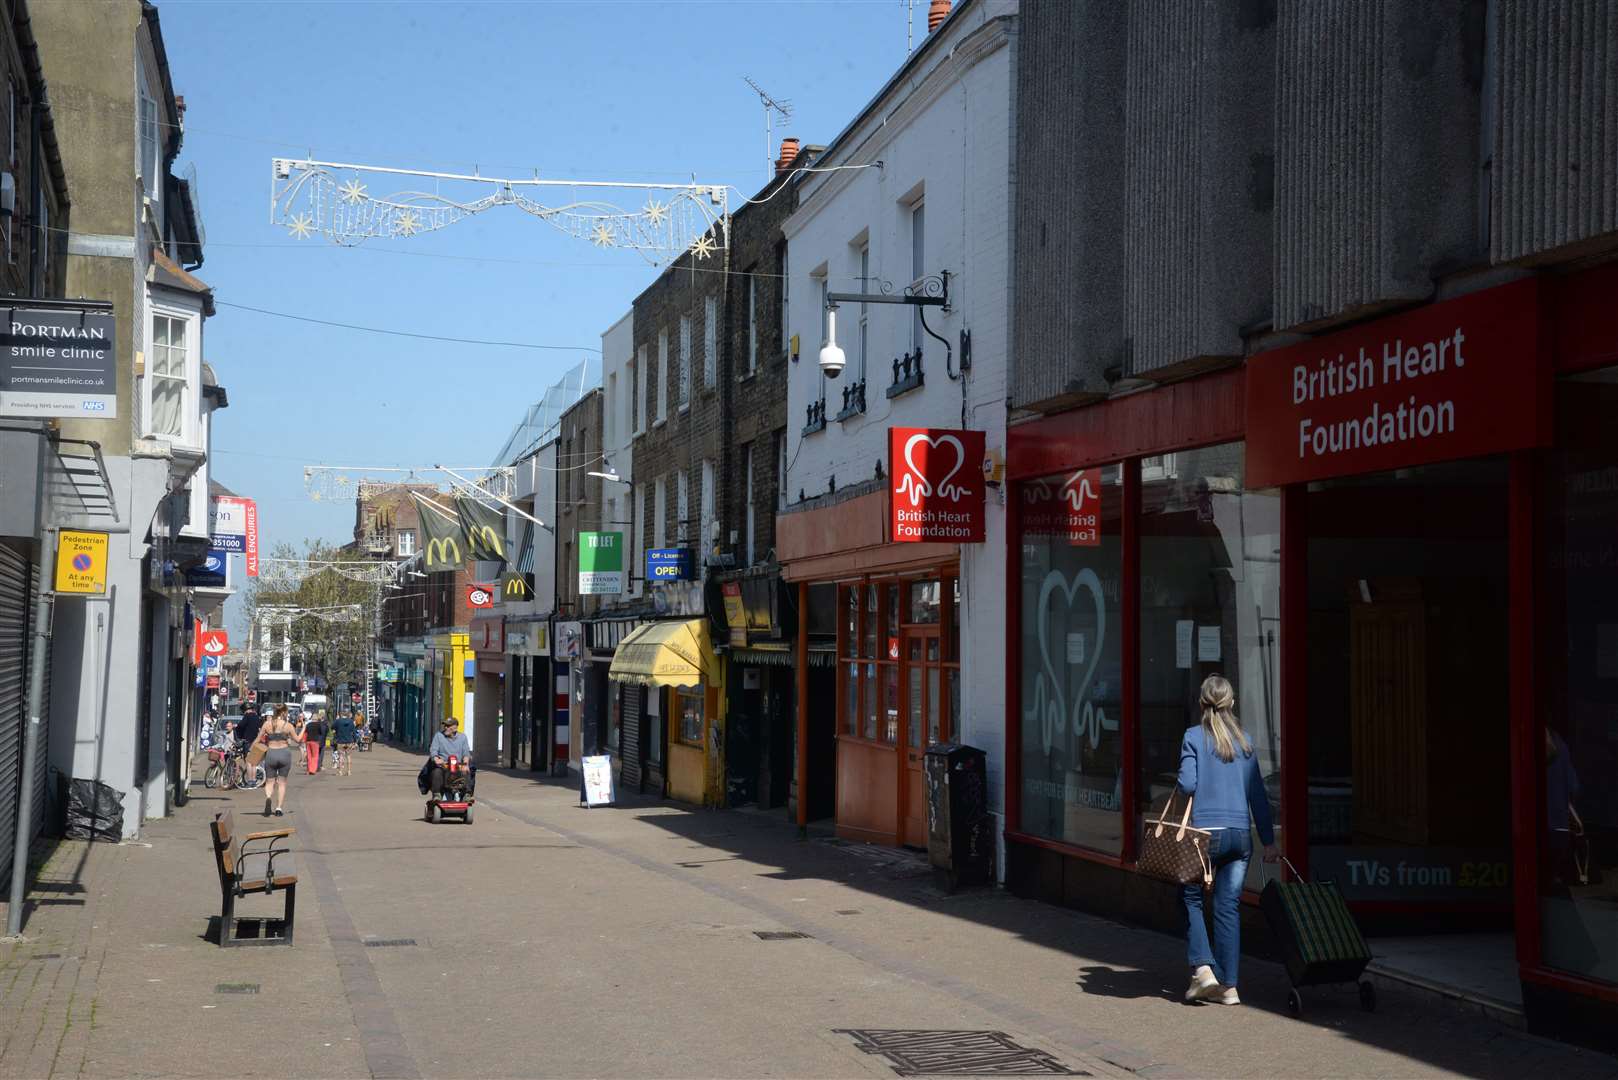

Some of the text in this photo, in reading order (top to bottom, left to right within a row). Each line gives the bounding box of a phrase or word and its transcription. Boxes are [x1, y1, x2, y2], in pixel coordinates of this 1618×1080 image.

[12, 322, 104, 341] PORTMAN
[11, 345, 104, 359] smile clinic
[1293, 327, 1466, 405] British Heart
[11, 375, 104, 386] portmansmileclinic.co.uk
[84, 401, 104, 410] NHS
[1299, 394, 1456, 459] Foundation
[897, 509, 970, 523] British Heart
[897, 523, 971, 537] Foundation
[63, 535, 105, 544] Pedestrian
[248, 506, 256, 572] ALL ENQUIRIES
[588, 535, 614, 548] TO LET
[655, 566, 682, 576] OPEN
[1346, 860, 1508, 887] TVs from £20
